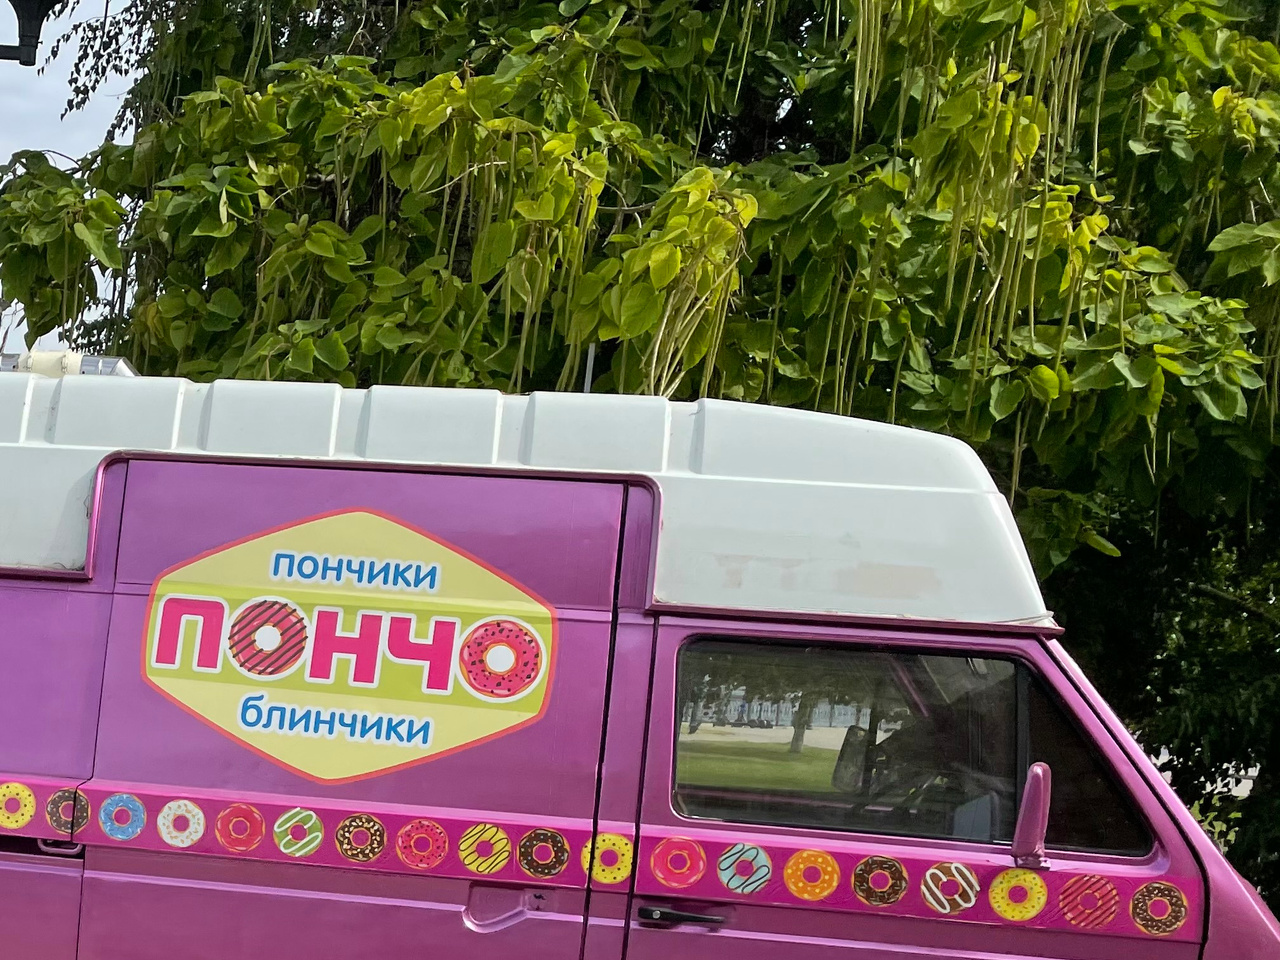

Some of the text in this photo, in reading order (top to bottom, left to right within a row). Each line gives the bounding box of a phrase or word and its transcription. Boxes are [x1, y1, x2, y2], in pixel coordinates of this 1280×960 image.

[273, 553, 438, 590] пончики
[154, 597, 543, 699] ПОНЧО
[240, 694, 431, 745] блинчики
